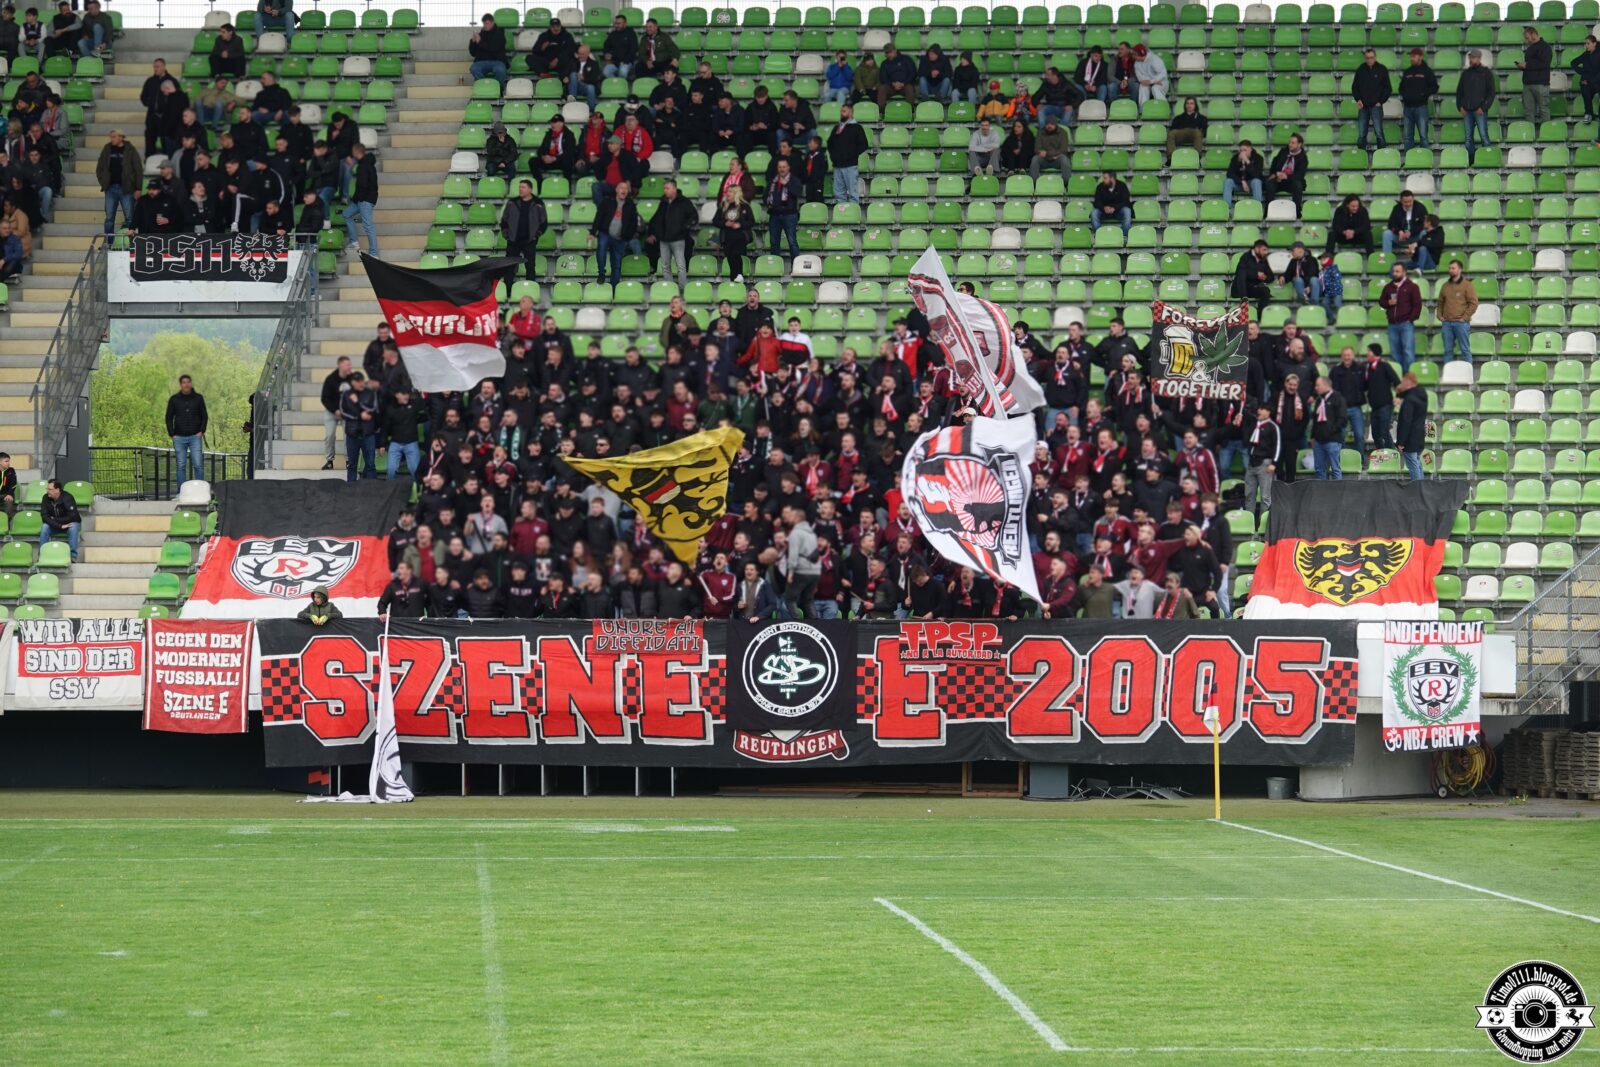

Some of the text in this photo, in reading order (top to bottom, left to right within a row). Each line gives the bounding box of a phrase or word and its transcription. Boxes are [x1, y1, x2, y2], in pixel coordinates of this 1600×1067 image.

[1161, 305, 1242, 328] FOREVER
[1157, 379, 1242, 400] TOGETHER
[1001, 458, 1023, 557] REUTLINGEN
[250, 539, 348, 554] SSV
[272, 558, 309, 576] R
[273, 584, 299, 597] 05
[18, 618, 144, 643] WIR ALLE
[674, 619, 696, 635] AI
[900, 621, 998, 651] TPSP
[1385, 620, 1483, 644] INDEPENDENT
[154, 632, 243, 649] GEGEN DEN
[596, 635, 700, 651] DIFFIDATI
[25, 647, 135, 673] SIND DER
[154, 651, 242, 667] MODERNEN
[906, 648, 993, 659] NO A LA AUTORIDAD
[155, 669, 239, 686] FUSSBALL!
[1414, 661, 1457, 676] SSV
[50, 677, 100, 700] SSV
[300, 634, 1331, 747] SZENE E 2005
[1428, 680, 1442, 697] R
[163, 689, 229, 714] SZENE E
[739, 732, 838, 756] REUTLINGEN
[1403, 725, 1465, 751] NBZ CREW
